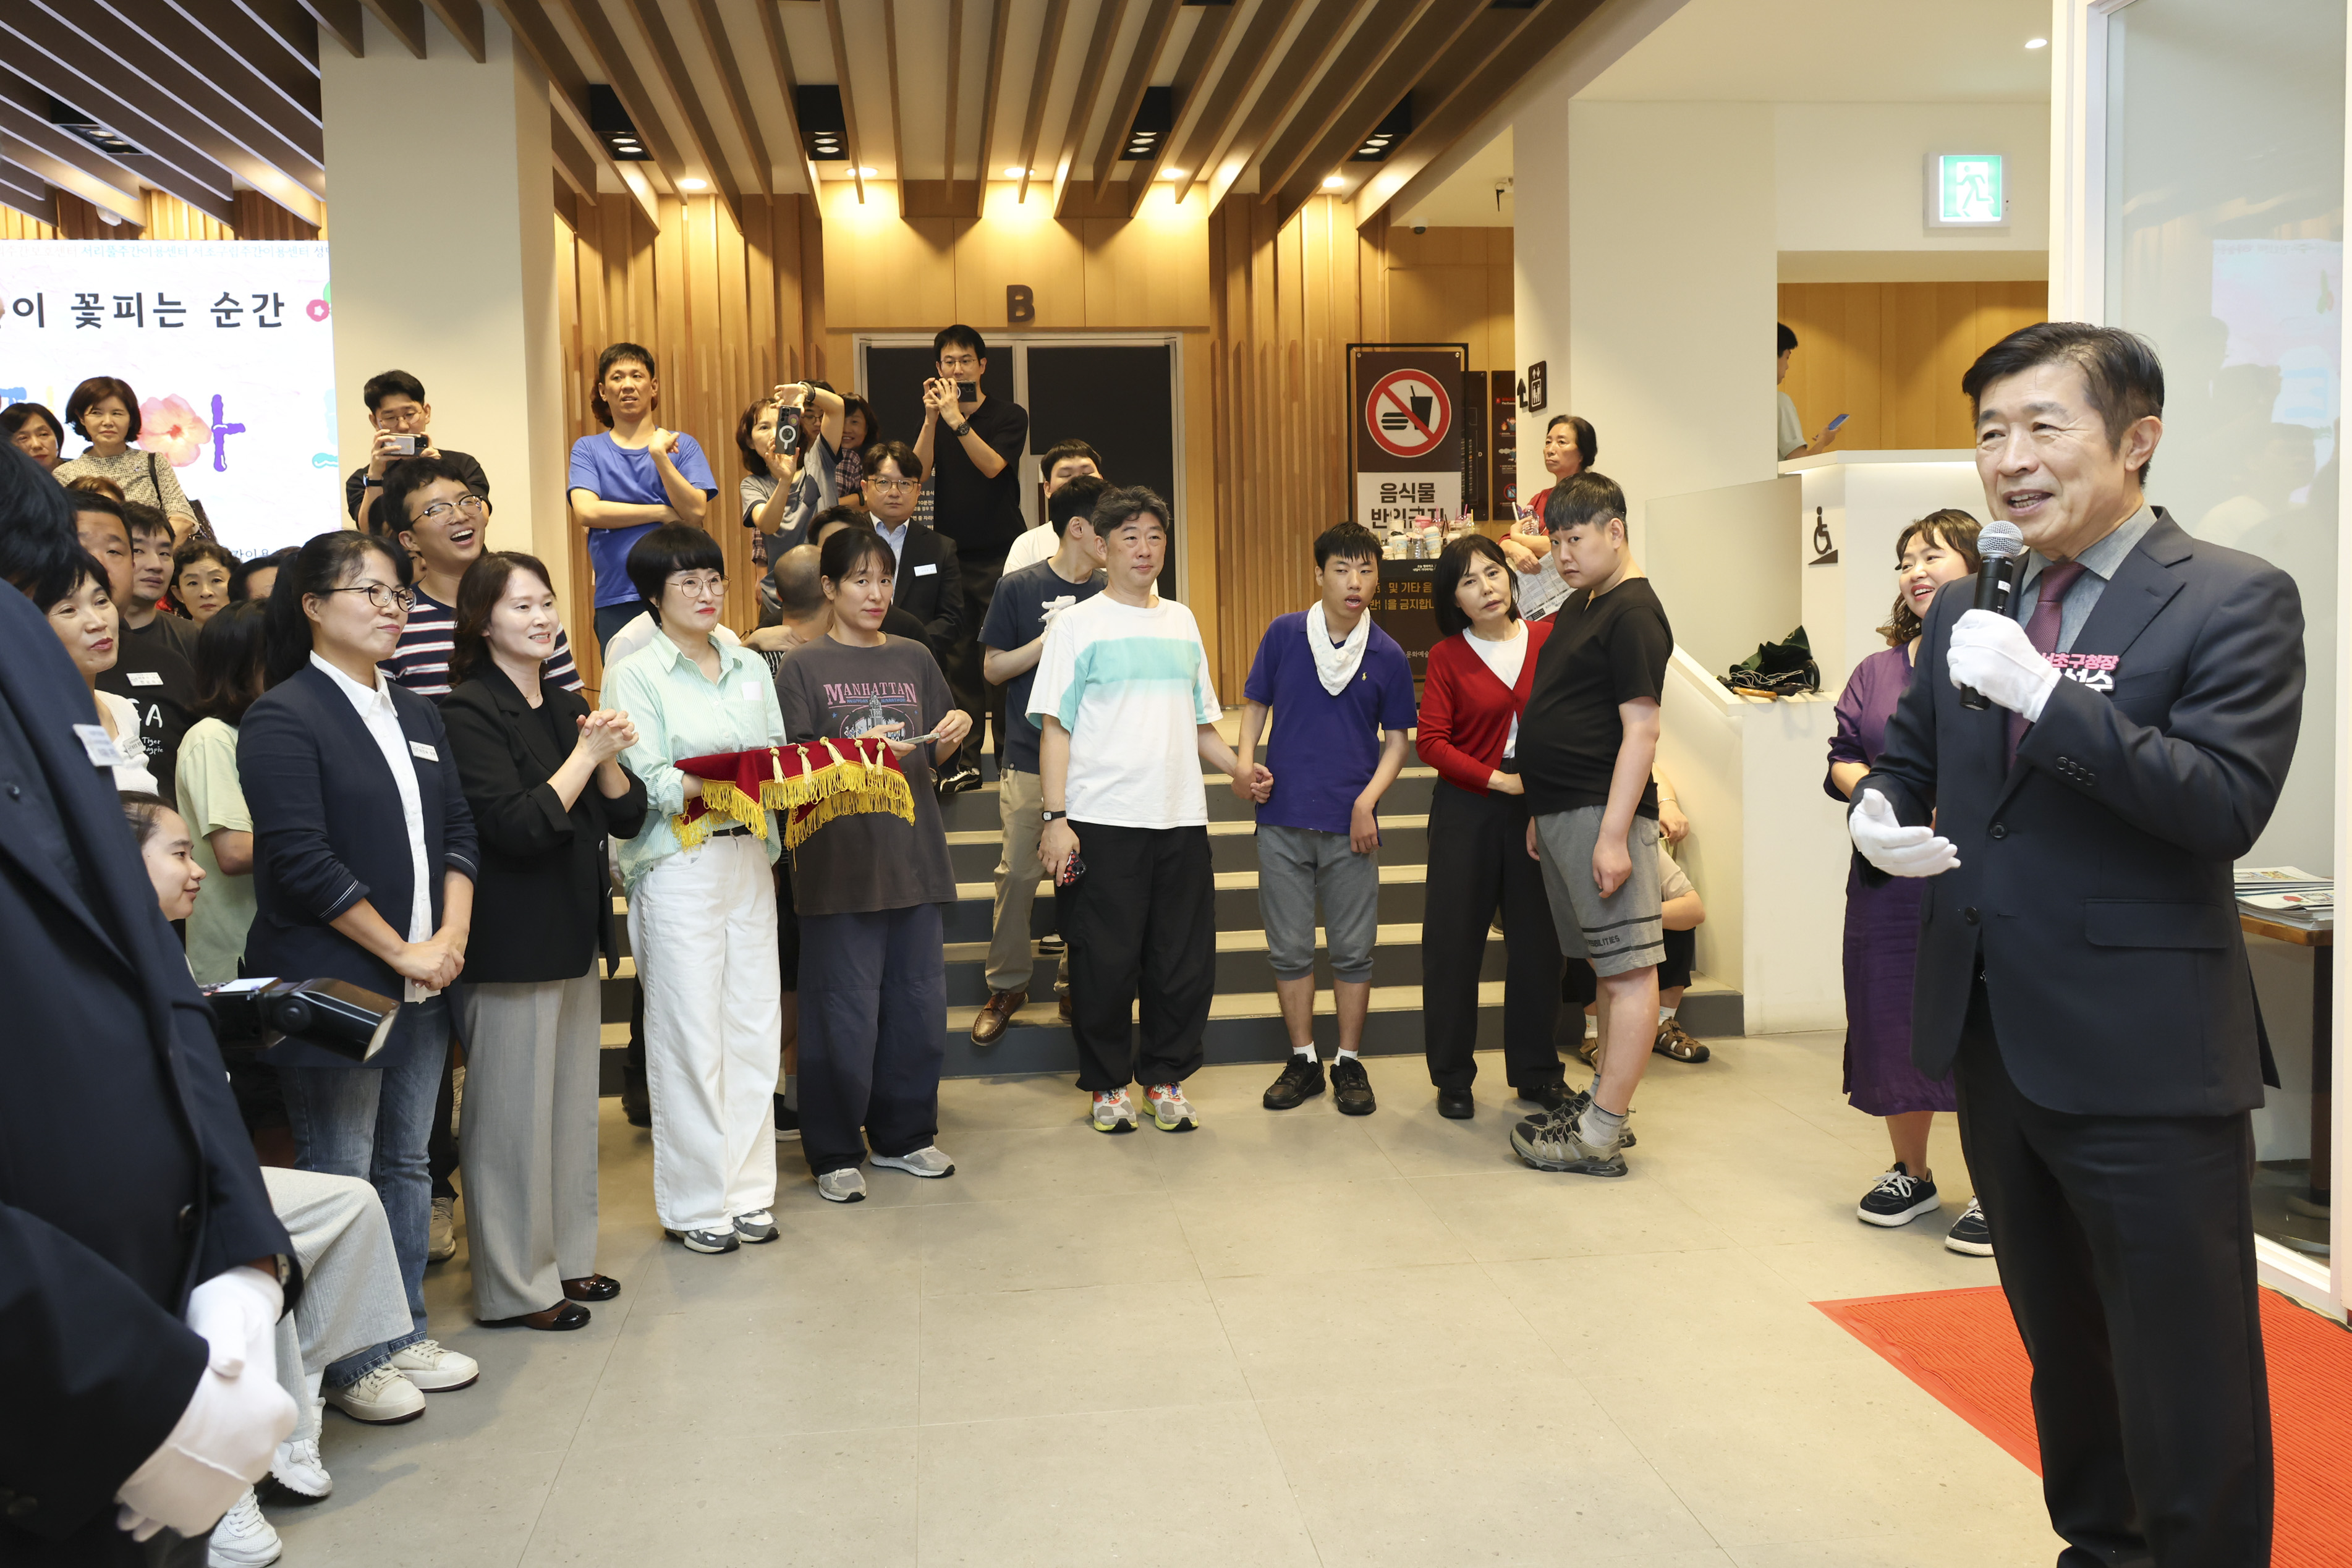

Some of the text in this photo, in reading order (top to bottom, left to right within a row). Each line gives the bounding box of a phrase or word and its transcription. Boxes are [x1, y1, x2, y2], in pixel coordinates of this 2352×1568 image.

[12, 292, 285, 329] 이 꽃피는 순간
[1006, 284, 1035, 323] B
[1380, 483, 1435, 503] 음식물
[1389, 582, 1398, 593] 및
[1401, 582, 1421, 593] 기타
[823, 682, 917, 705] MANHATTAN
[142, 737, 161, 747] Tiger
[145, 746, 164, 755] agpie
